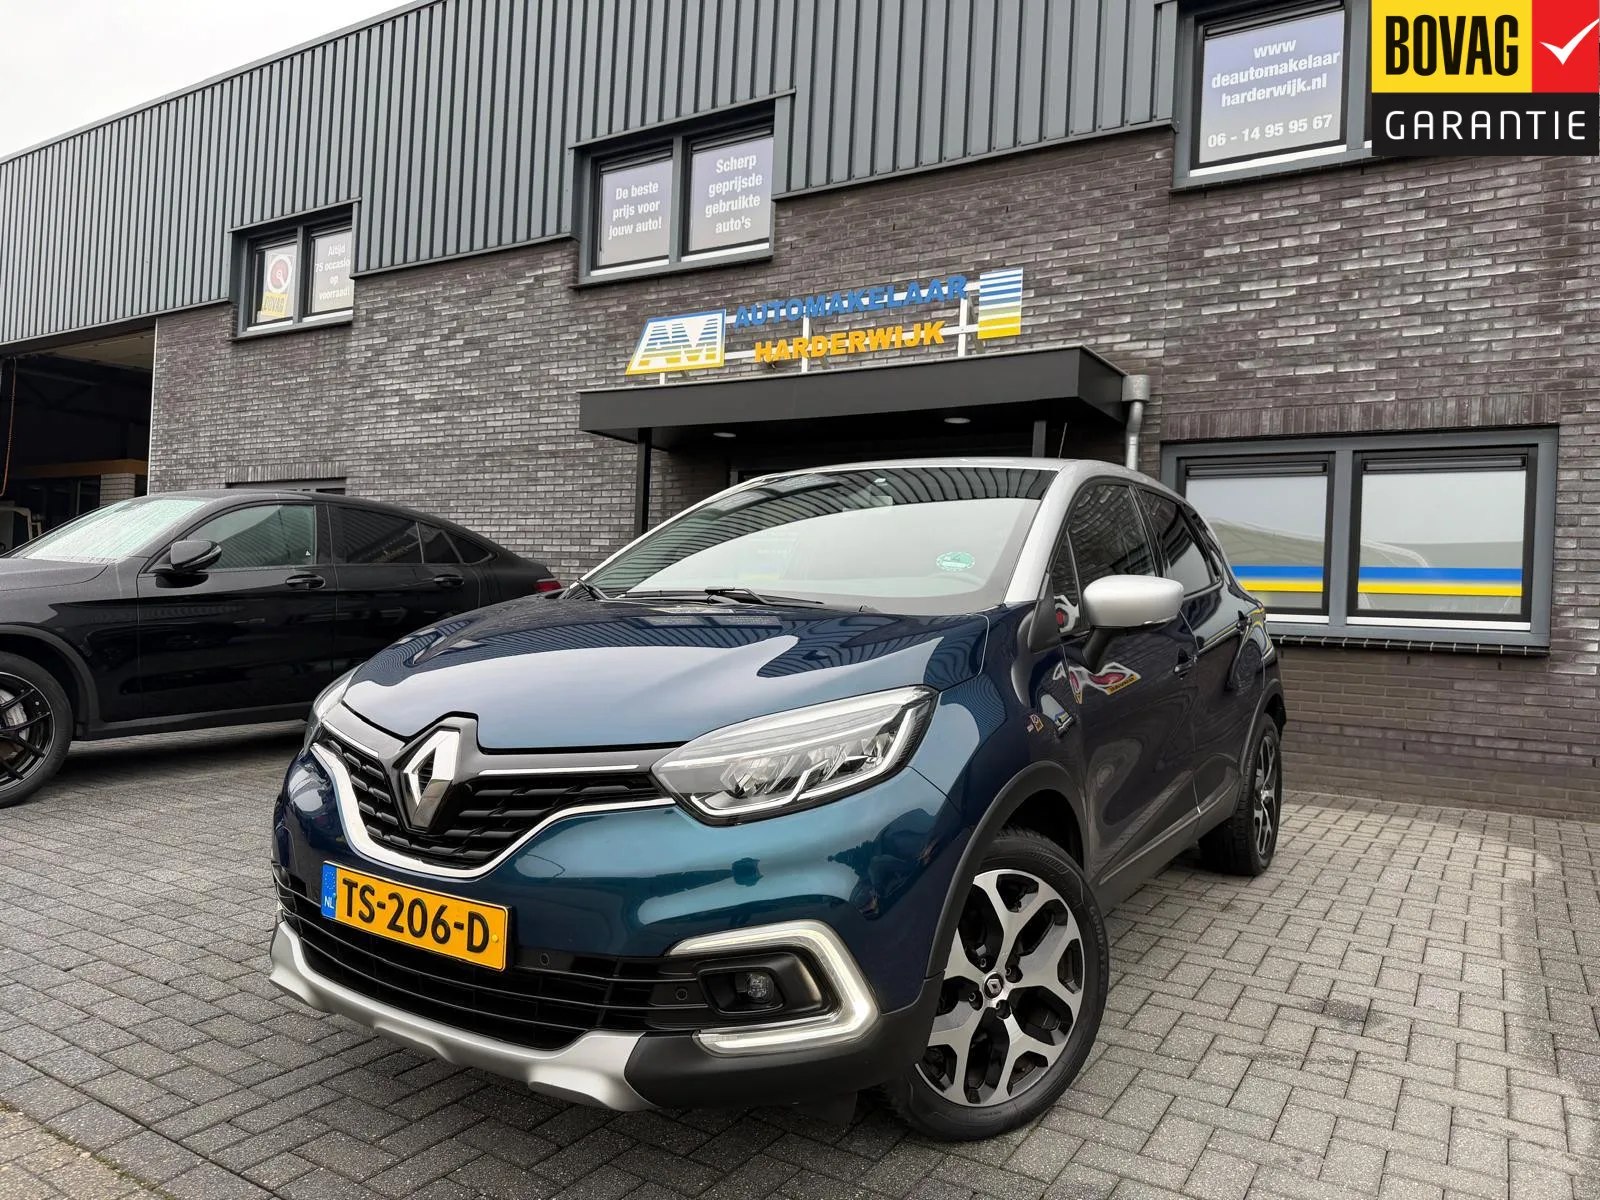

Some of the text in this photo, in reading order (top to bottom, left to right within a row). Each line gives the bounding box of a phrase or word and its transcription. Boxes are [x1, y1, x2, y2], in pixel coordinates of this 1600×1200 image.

[1253, 38, 1297, 60] www
[1211, 51, 1341, 88] deautomakelaar
[1221, 73, 1328, 107] harderwijk.nl
[1207, 131, 1226, 148] 06
[1241, 126, 1261, 143] 14
[1265, 122, 1284, 139] 95
[1288, 119, 1309, 136] 95
[1312, 113, 1334, 131] 67
[715, 155, 757, 173] Scherp
[615, 181, 659, 200] De beste
[708, 173, 763, 198] geprijsde
[612, 200, 661, 222] prijs voor
[705, 194, 761, 218] gebruikte
[608, 216, 662, 240] jouw auto!
[715, 216, 752, 233] auto's
[325, 257, 350, 271] occasio
[734, 274, 968, 329] AUTOMAKELAAR
[754, 321, 945, 362] HARDERWIJK
[324, 895, 334, 909] NL
[342, 877, 490, 954] TS-206-D
